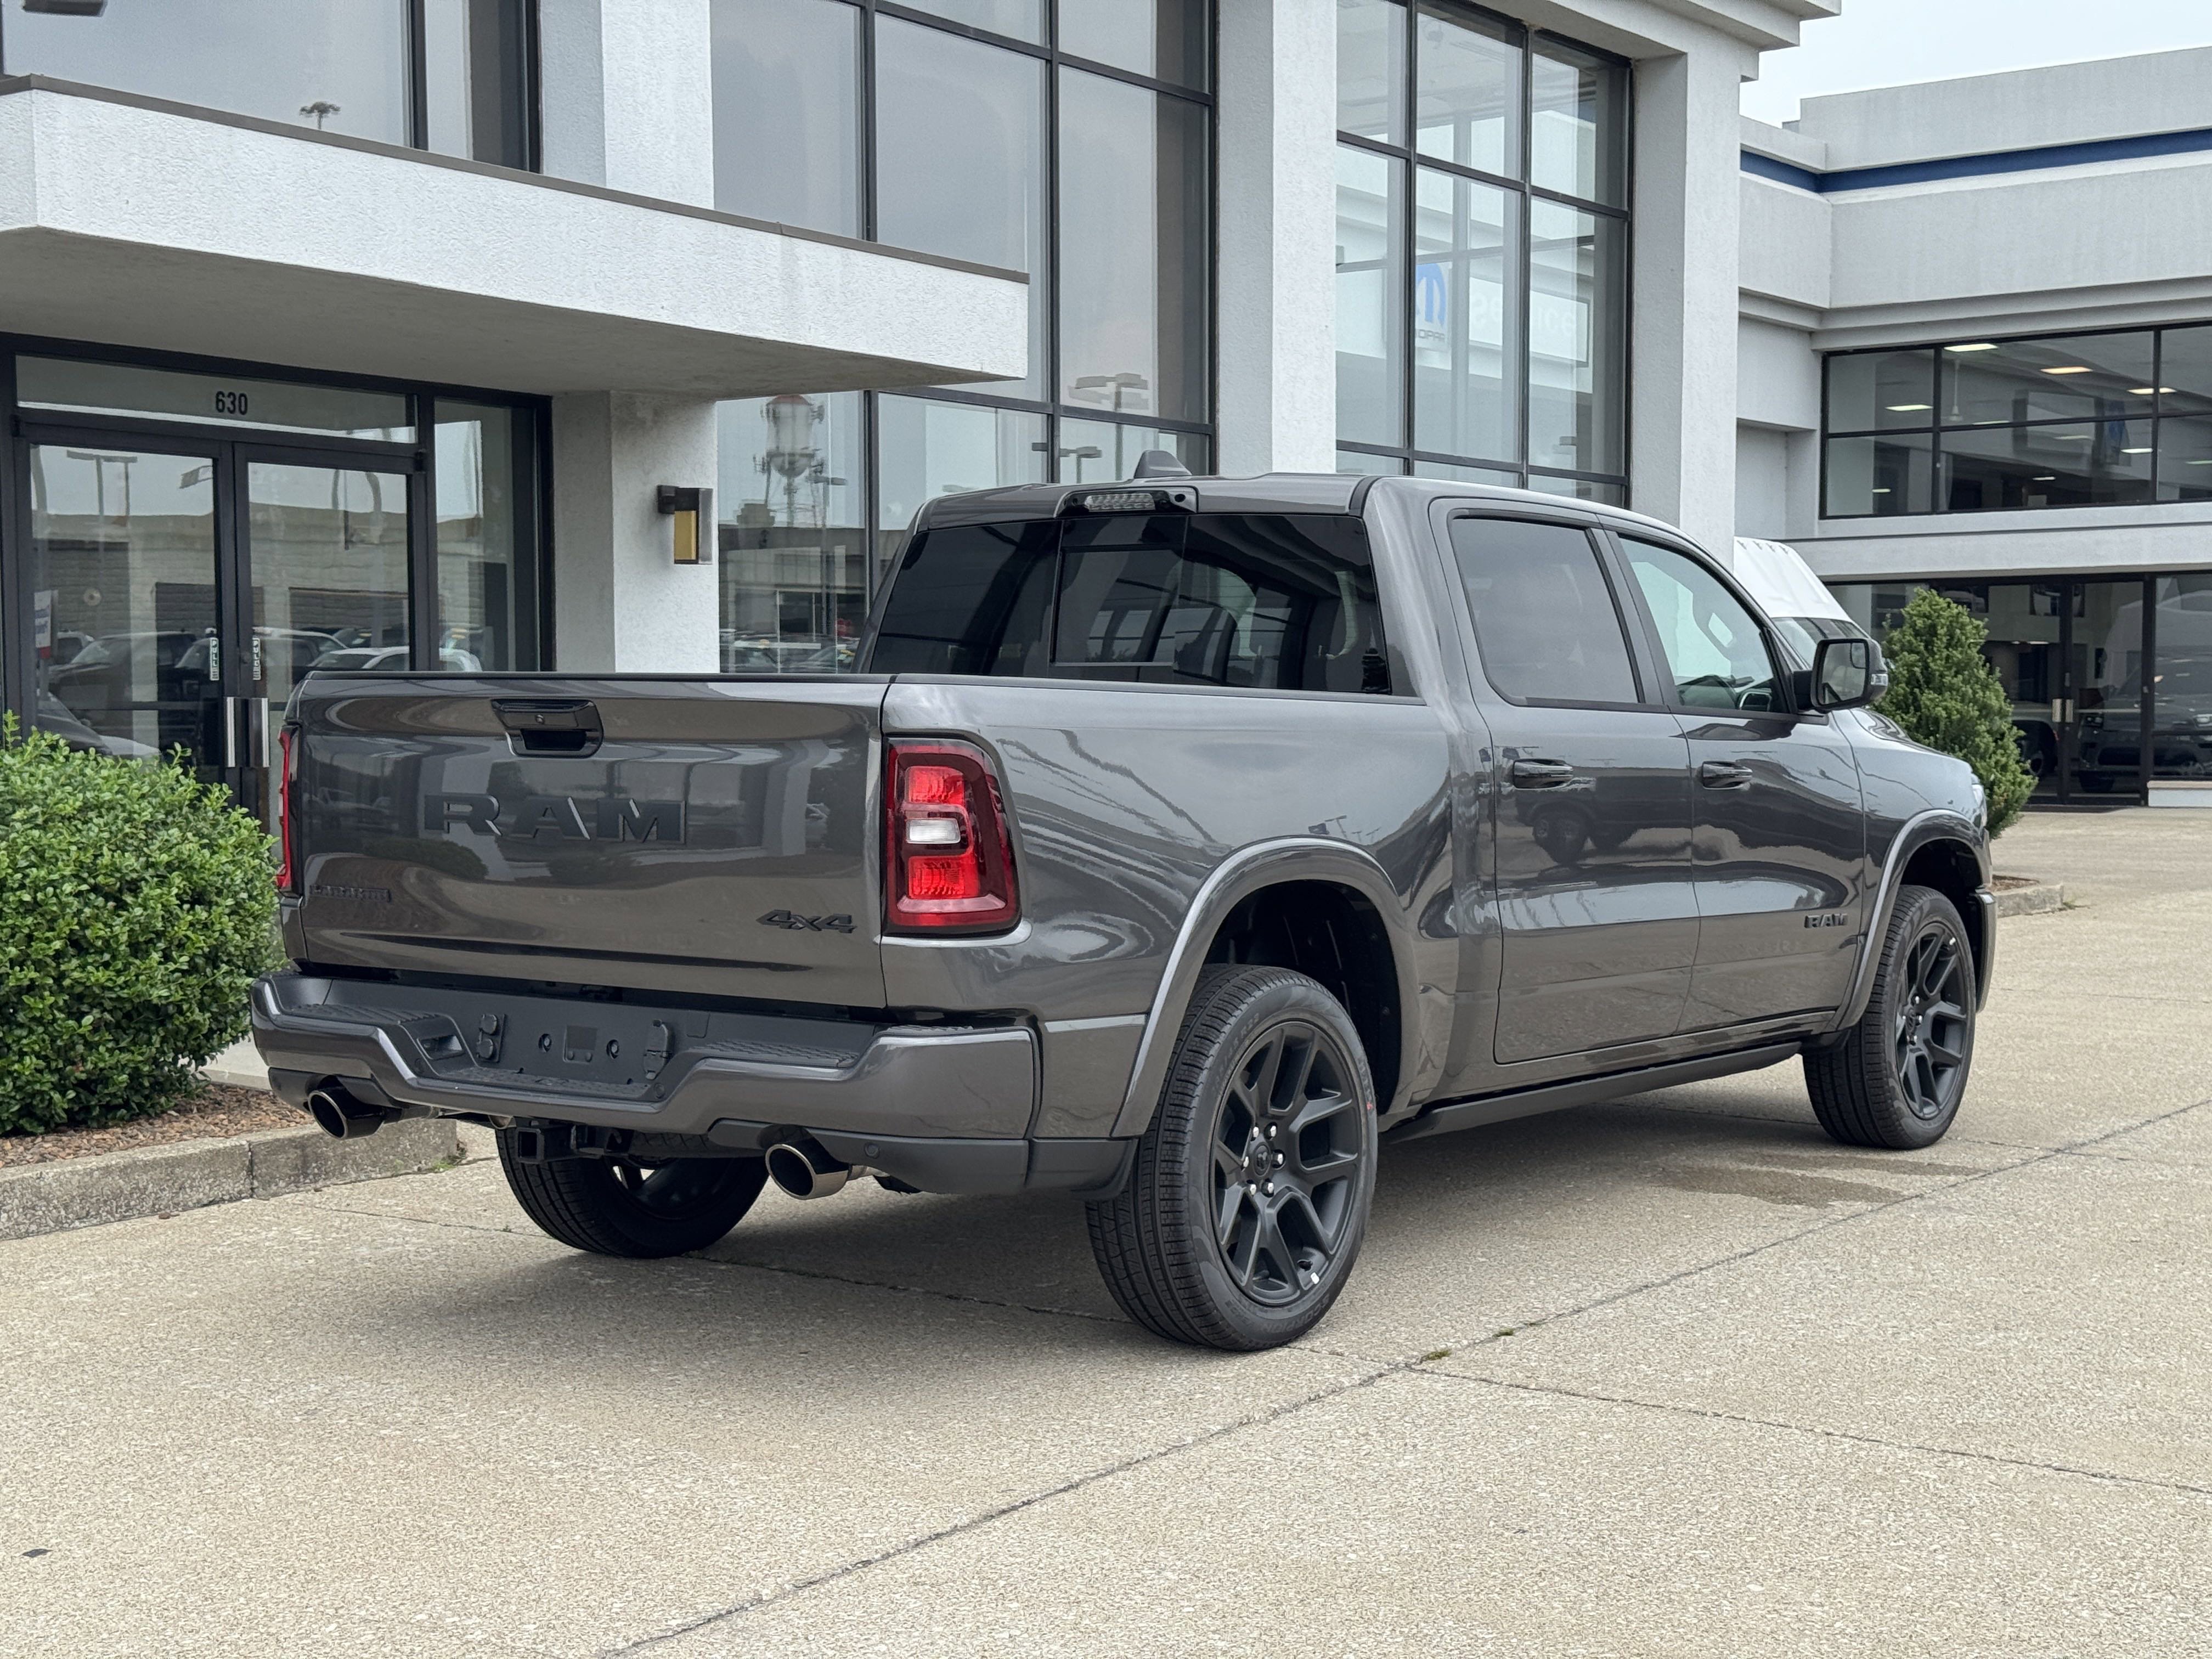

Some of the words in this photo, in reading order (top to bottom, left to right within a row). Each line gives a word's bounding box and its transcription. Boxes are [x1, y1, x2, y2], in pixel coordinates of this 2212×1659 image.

[1415, 329, 1446, 341] OPAR
[216, 391, 248, 415] 630
[421, 793, 687, 844] RAM
[1804, 913, 1848, 928] RAM
